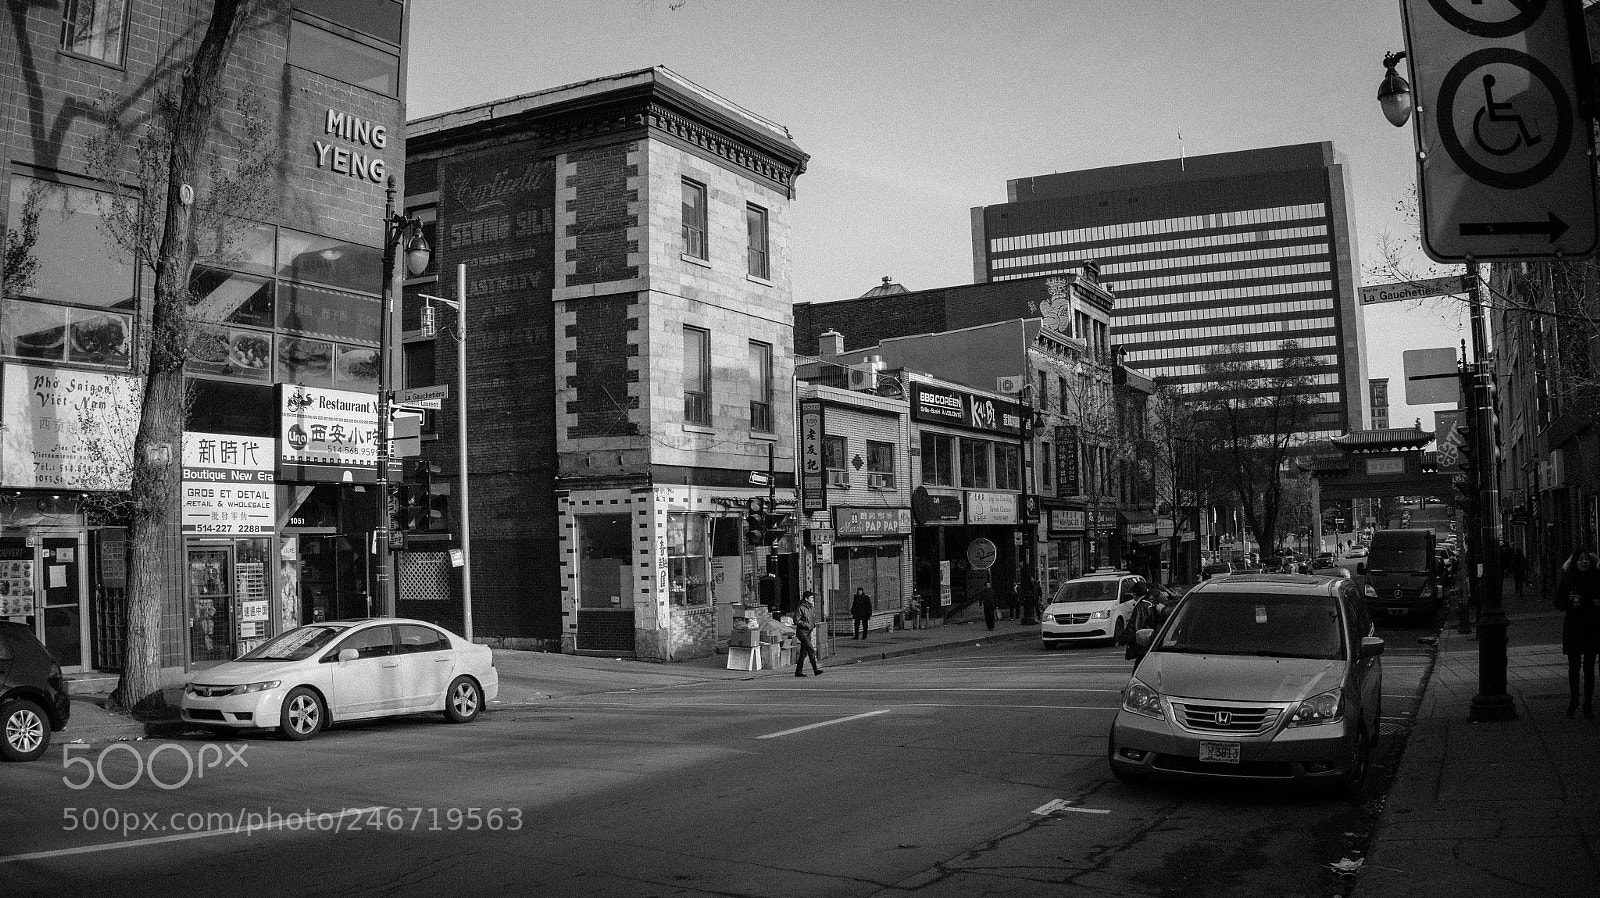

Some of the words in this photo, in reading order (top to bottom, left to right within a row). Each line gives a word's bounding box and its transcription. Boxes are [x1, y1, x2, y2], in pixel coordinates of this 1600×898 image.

[325, 109, 387, 150] MING
[313, 140, 386, 183] YENG
[450, 214, 510, 248] SEWING
[1363, 293, 1375, 303] La
[66, 379, 110, 396] Saigon
[920, 391, 935, 403] BBQ
[319, 395, 370, 414] Restaurant
[198, 438, 260, 466] 新時代
[327, 445, 379, 457] 514.568.959
[183, 469, 227, 482] Boutique
[231, 470, 253, 481] New
[257, 471, 274, 481] Era
[187, 488, 214, 498] GROS
[220, 489, 231, 498] ET
[237, 490, 269, 499] DETAIL
[290, 517, 305, 525] 1051
[865, 520, 881, 532] PAP
[883, 520, 898, 532] PAP
[196, 524, 232, 533] 514-227
[238, 525, 260, 533] 2288
[1215, 747, 1238, 759] 3813
